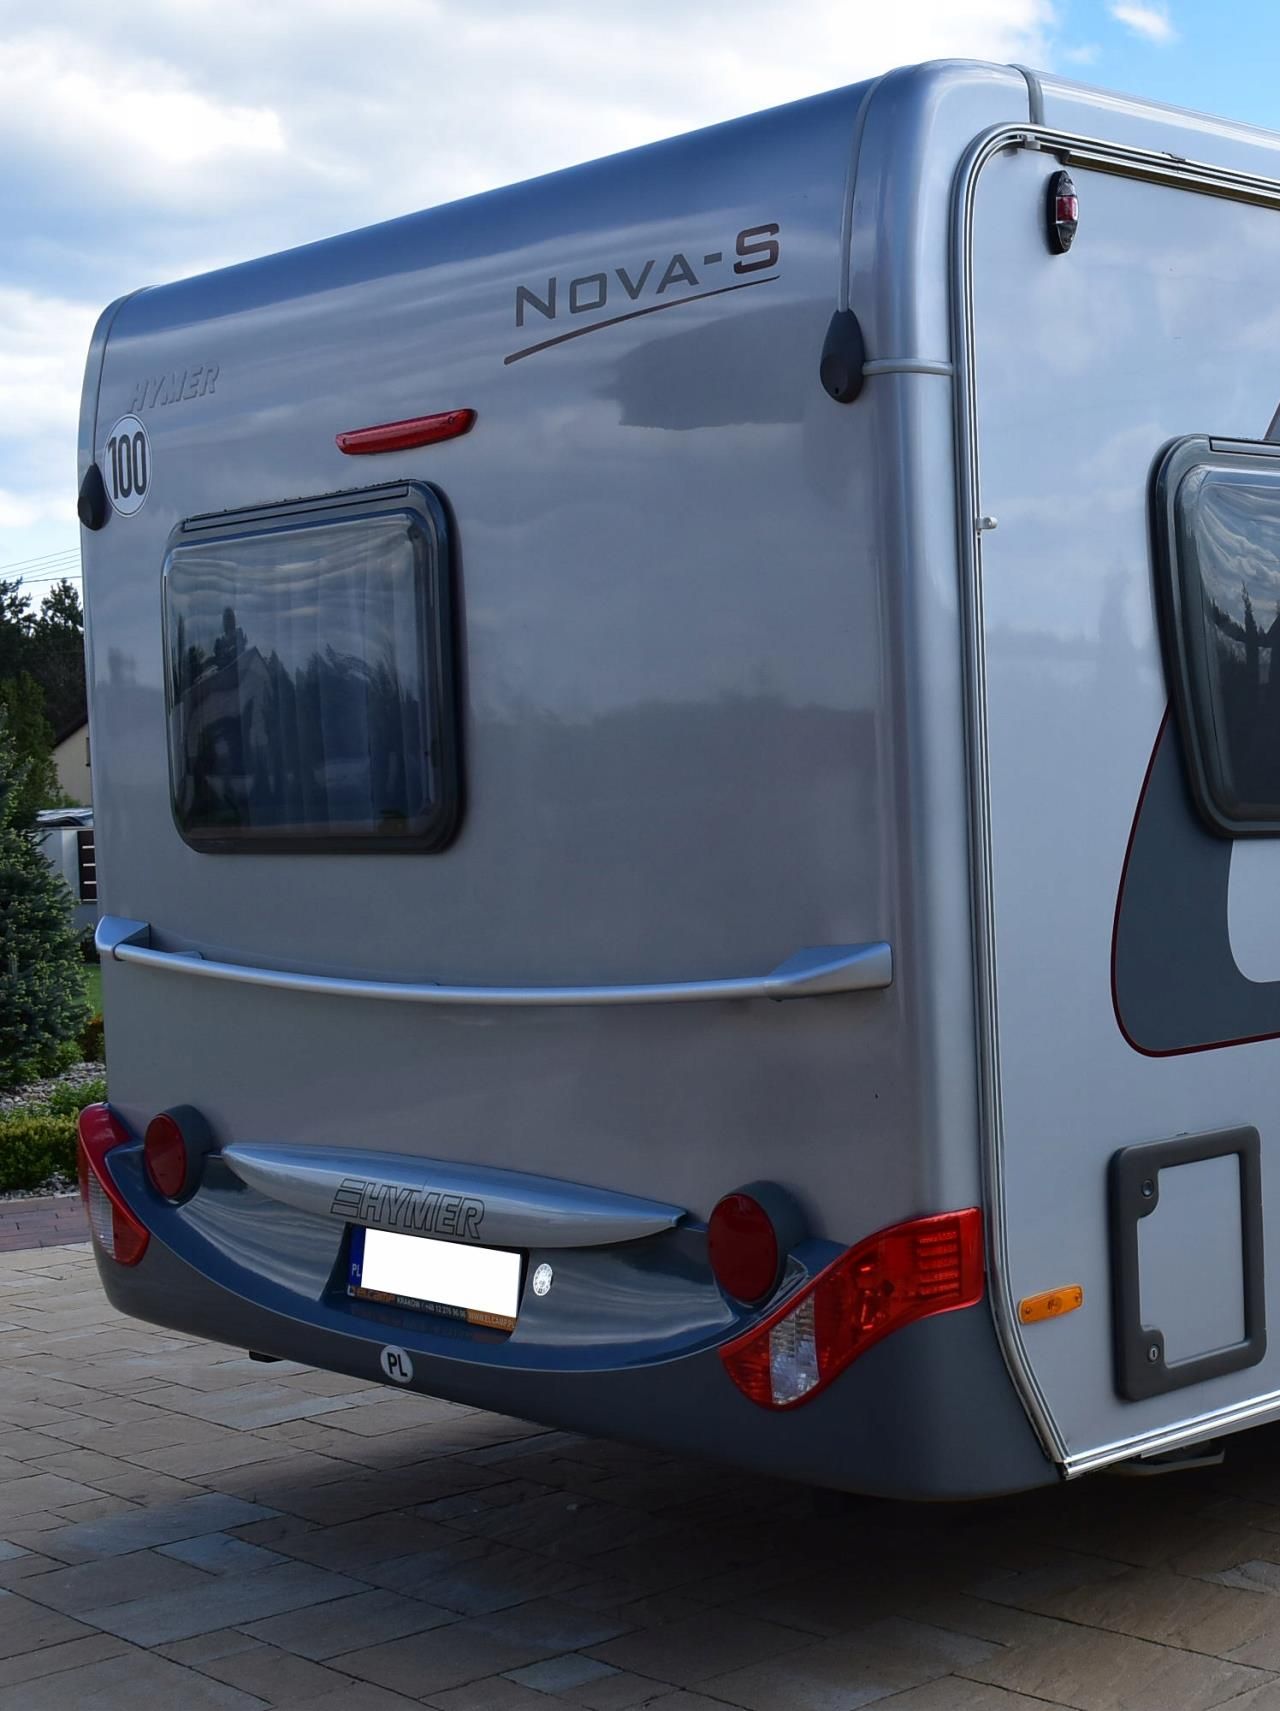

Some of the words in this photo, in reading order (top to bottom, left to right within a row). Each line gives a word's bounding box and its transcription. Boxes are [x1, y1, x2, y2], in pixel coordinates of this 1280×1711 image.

[515, 222, 780, 328] NOVA-S
[129, 362, 220, 413] HYMER
[108, 431, 147, 499] 100
[359, 1183, 485, 1239] HYMER
[352, 1263, 361, 1277] PL
[387, 1351, 408, 1377] PL
